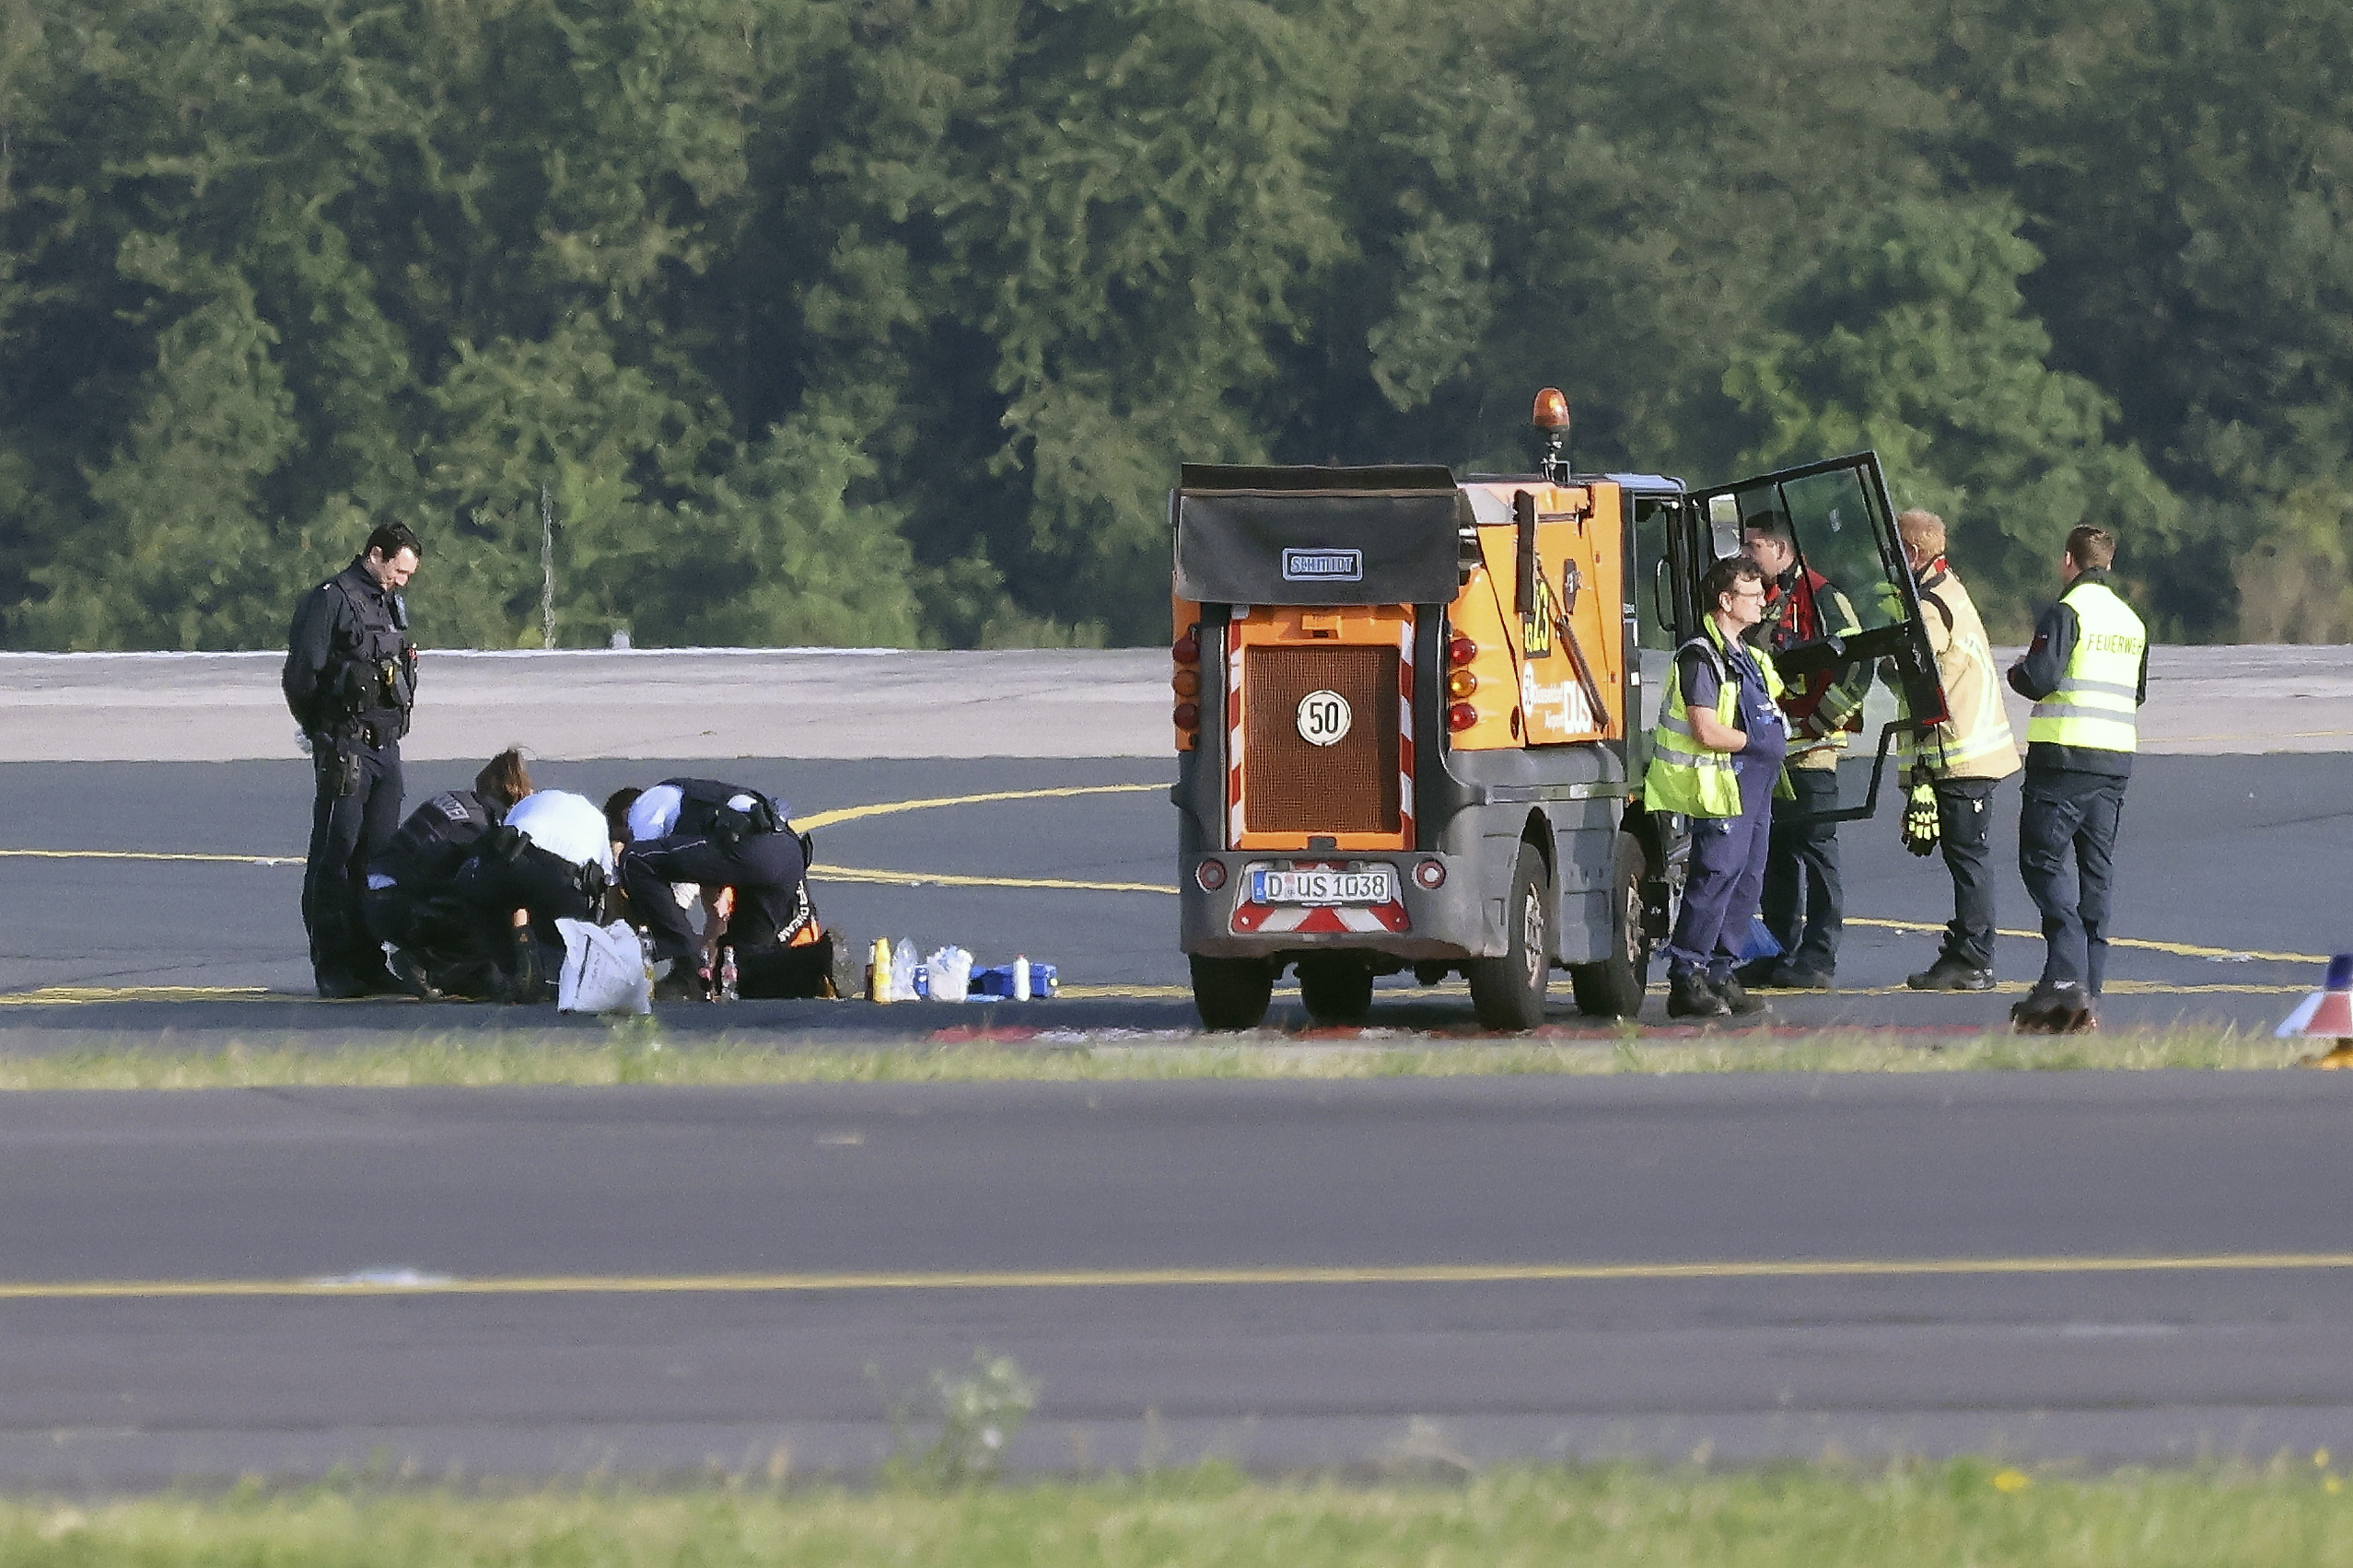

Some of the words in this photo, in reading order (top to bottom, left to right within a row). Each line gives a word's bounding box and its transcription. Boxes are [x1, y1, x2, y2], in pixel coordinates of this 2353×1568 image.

[2087, 633, 2144, 656] FEUERWEH
[1310, 702, 1339, 735] 50
[1268, 876, 1282, 897] D
[1298, 876, 1327, 897] US
[1333, 876, 1384, 897] 1038
